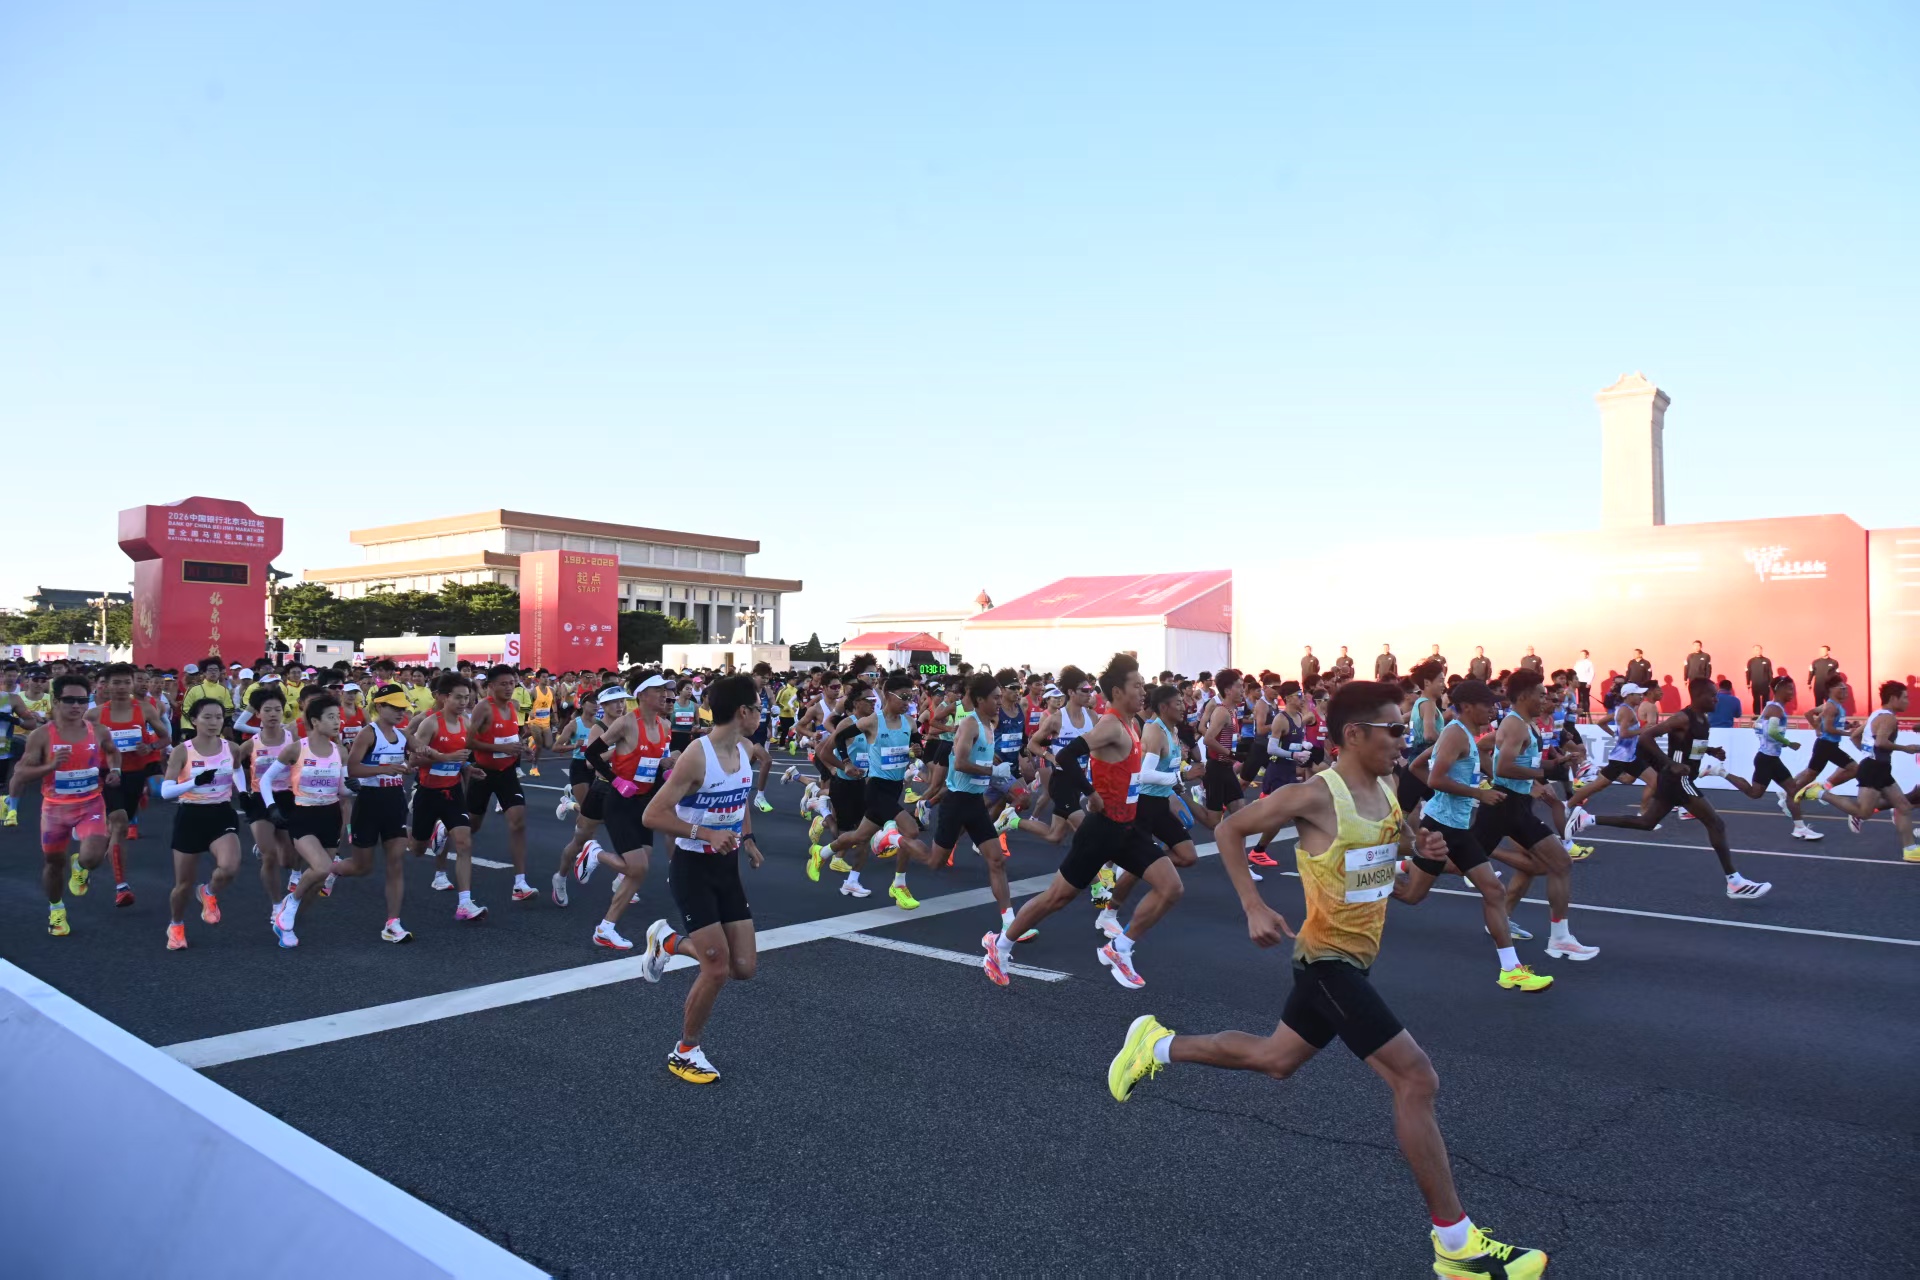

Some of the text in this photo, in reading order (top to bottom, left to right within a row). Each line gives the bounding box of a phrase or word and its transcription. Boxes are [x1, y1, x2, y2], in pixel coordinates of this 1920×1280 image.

[168, 511, 264, 528] 2026中国银行北京马拉松
[564, 556, 615, 567] 1981-2026
[577, 571, 601, 585] 起点
[577, 585, 601, 593] START
[13, 648, 22, 657] B
[430, 641, 439, 657] A
[508, 640, 520, 657] S
[310, 779, 331, 787] CHOE
